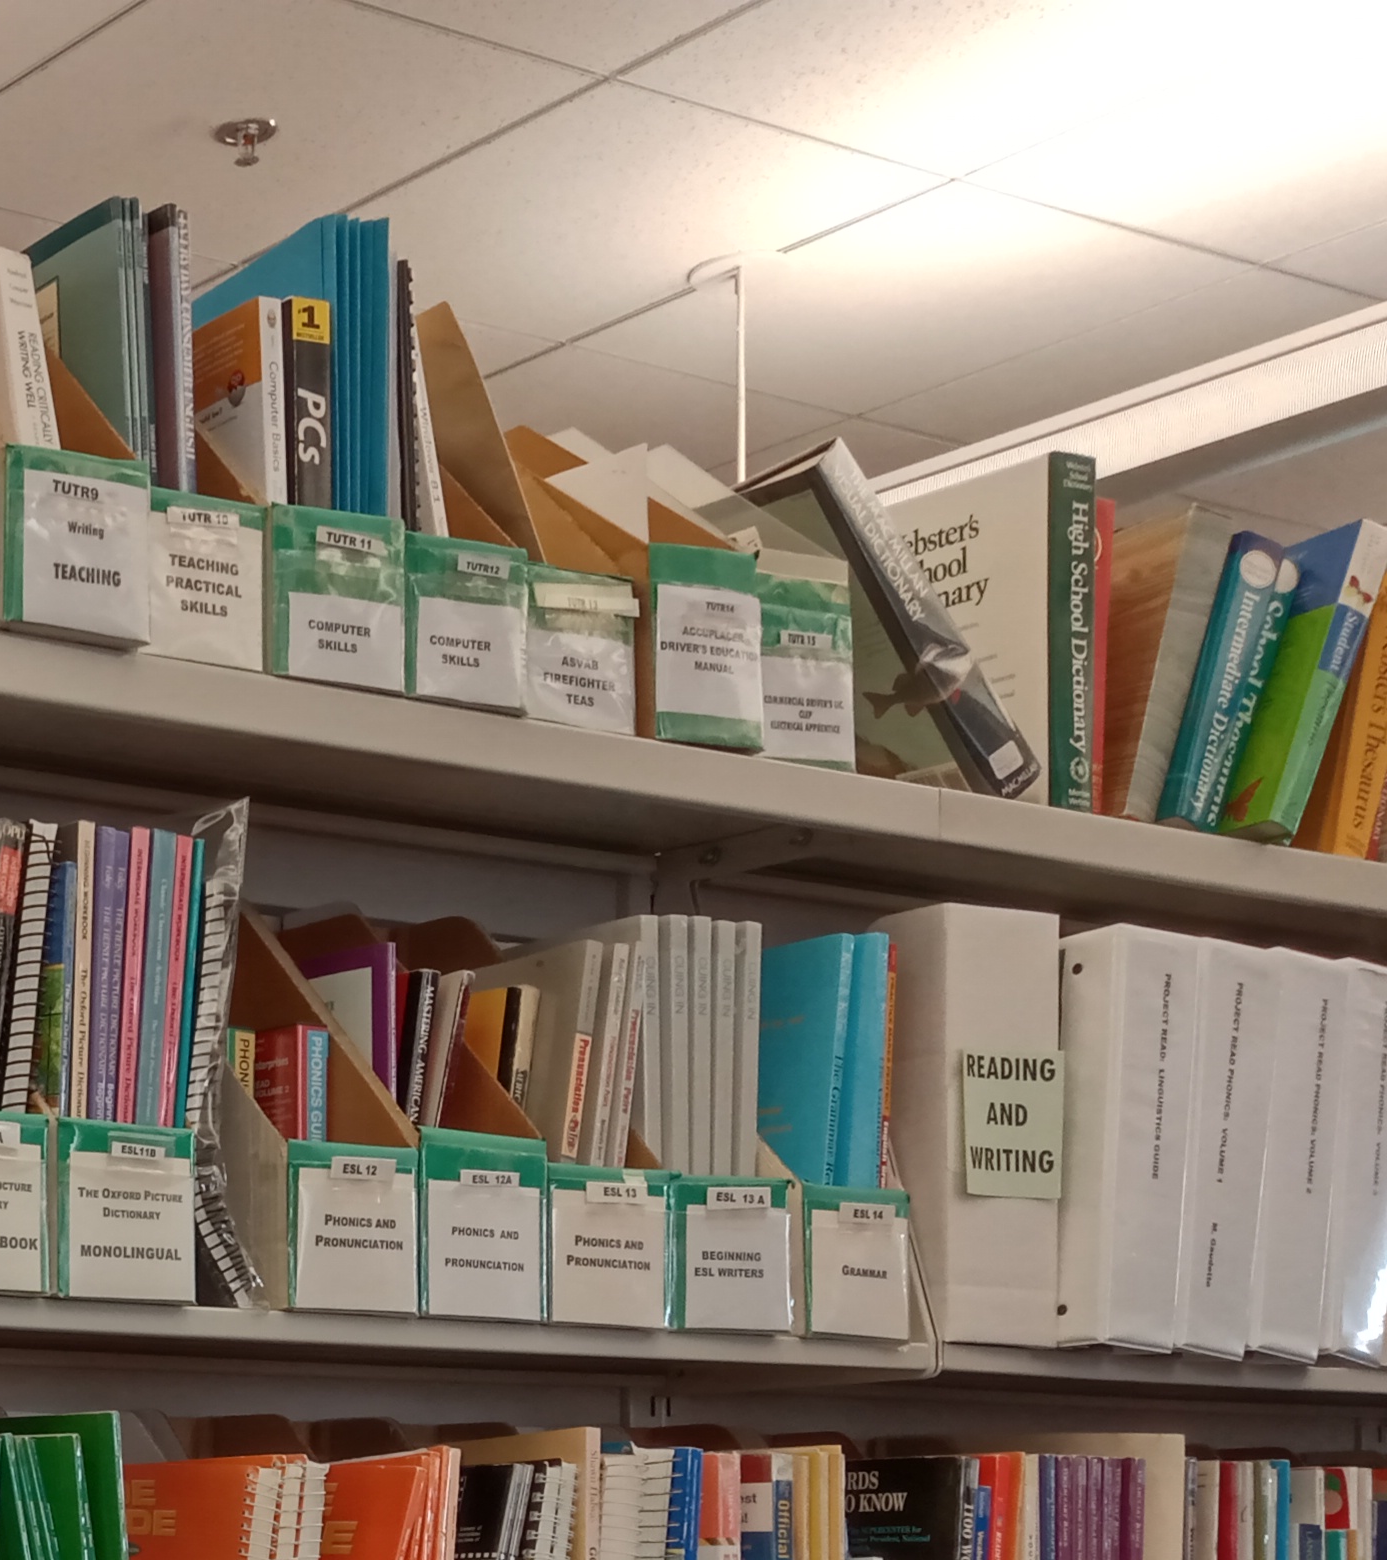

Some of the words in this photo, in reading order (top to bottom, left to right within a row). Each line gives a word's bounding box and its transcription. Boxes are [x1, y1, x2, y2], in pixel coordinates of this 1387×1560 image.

[298, 388, 326, 464] PCs
[53, 479, 98, 501] TUTR9
[1067, 500, 1090, 556] High
[169, 554, 238, 576] TEACHING
[167, 576, 242, 598] PRACTICAL
[1071, 560, 1089, 633] School
[308, 620, 370, 637] COMPUTER
[318, 639, 357, 653] SKILLS
[1217, 590, 1261, 709] Intermediate
[1069, 637, 1089, 753] Dictionary
[1189, 712, 1229, 818] Dictionary
[967, 1054, 1055, 1081] READING
[987, 1102, 1027, 1126] AND
[970, 1146, 1054, 1173] WRITING
[0, 1236, 37, 1250] BOOK
[702, 1251, 761, 1261] BEGINNING
